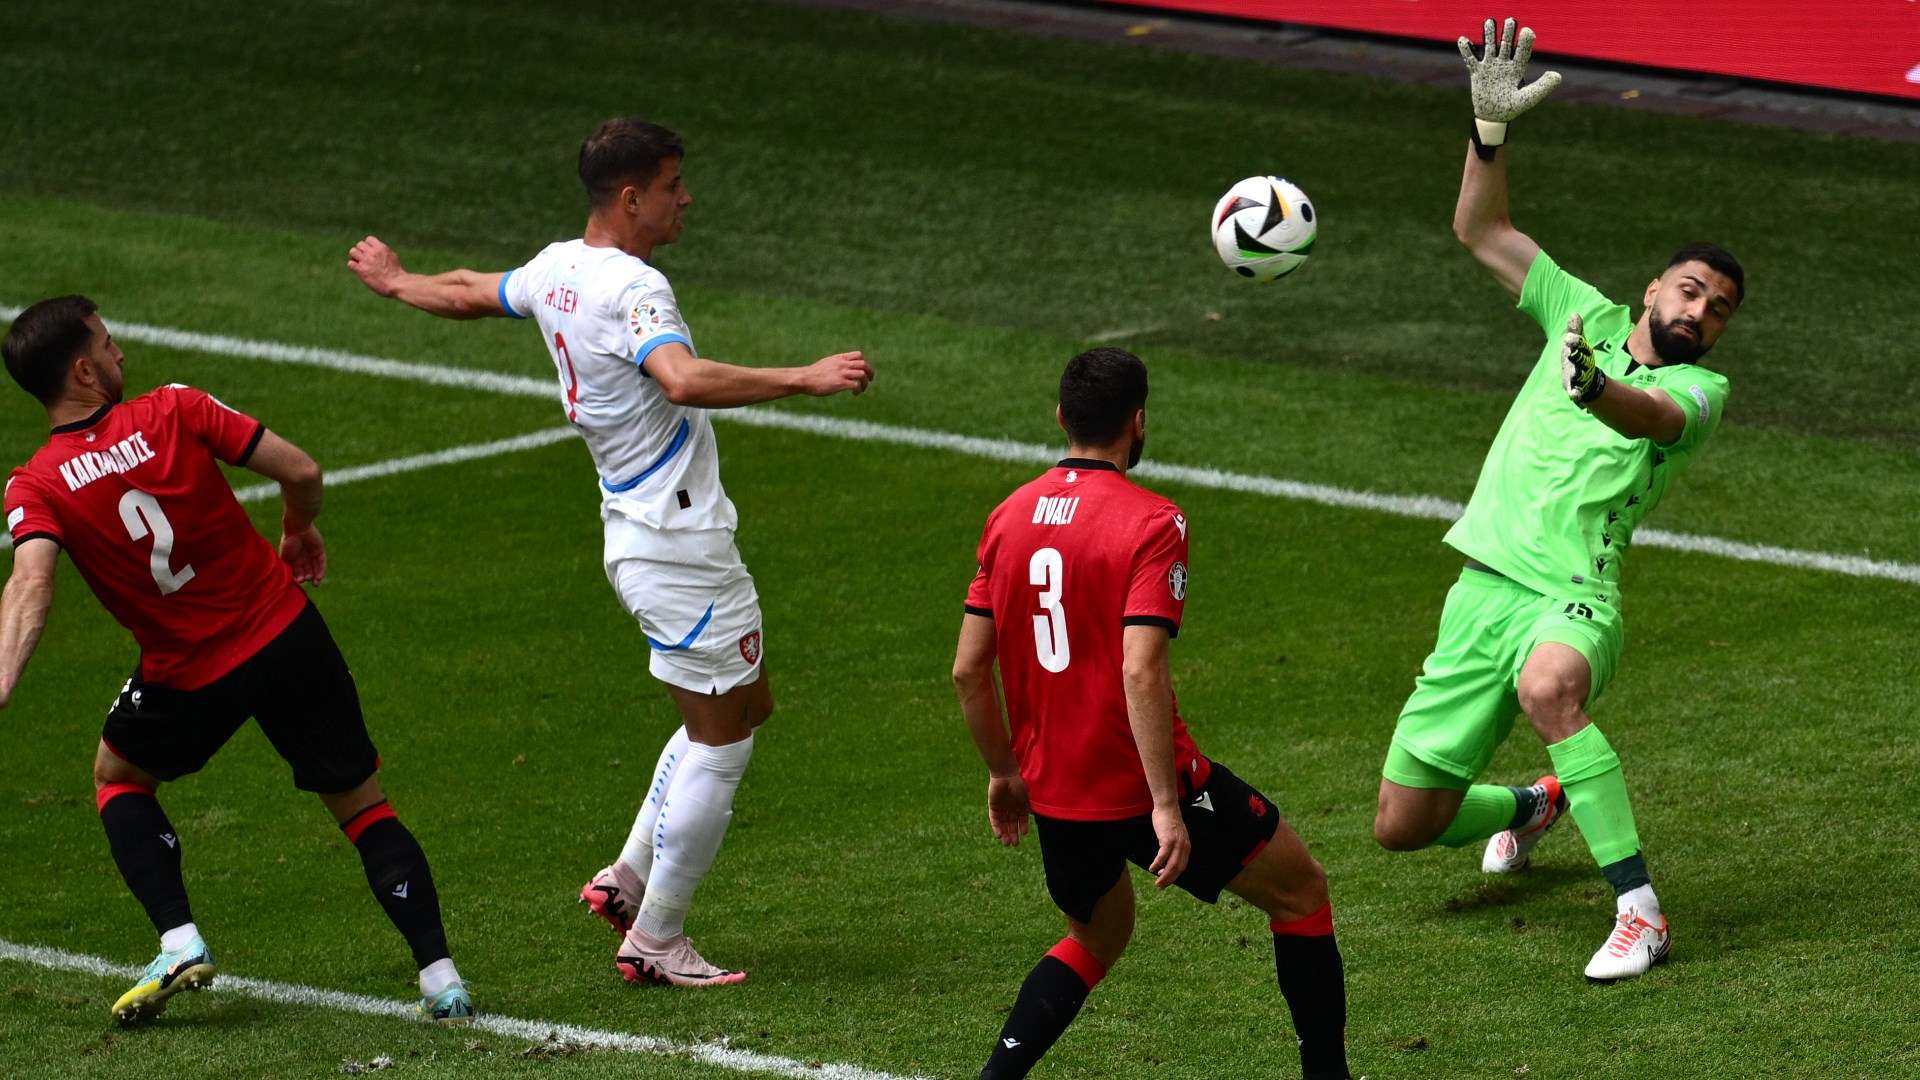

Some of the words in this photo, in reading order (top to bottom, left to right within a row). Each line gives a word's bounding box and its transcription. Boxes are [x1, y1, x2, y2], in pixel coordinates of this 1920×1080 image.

[118, 489, 196, 596] 2
[1032, 496, 1080, 525] DVALI
[1029, 547, 1071, 673] 3
